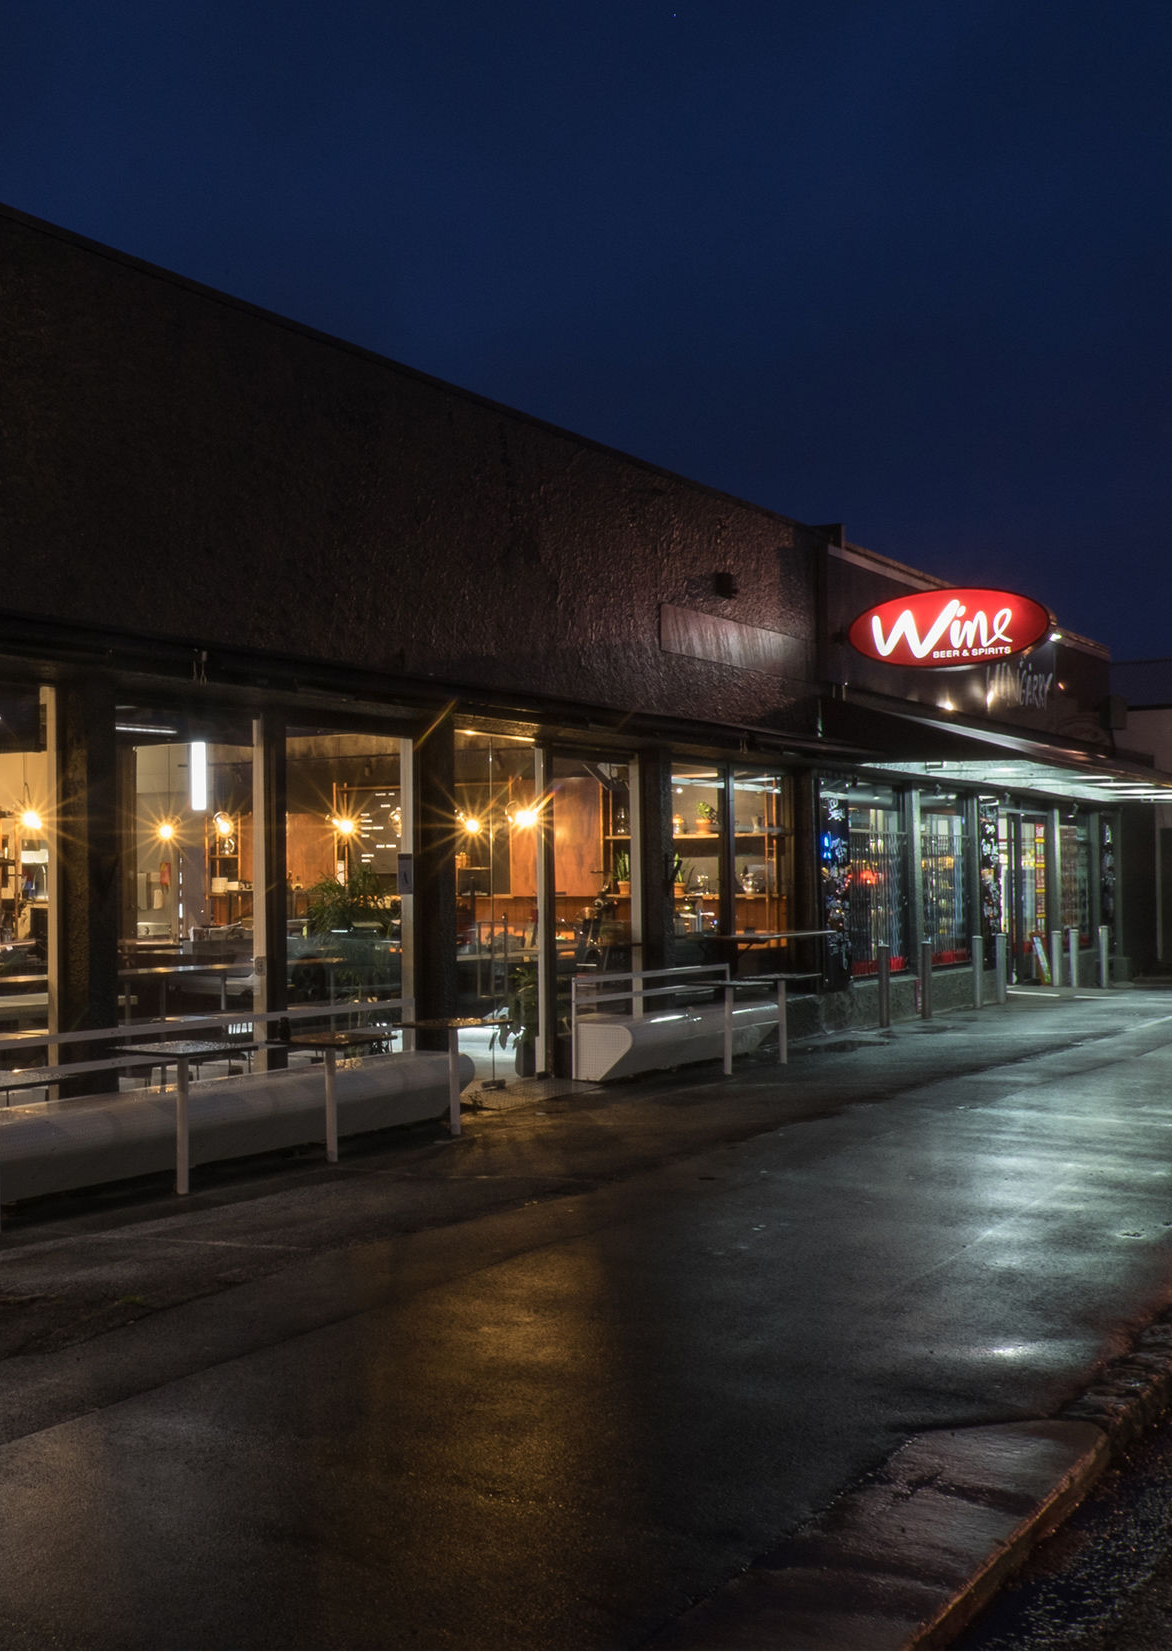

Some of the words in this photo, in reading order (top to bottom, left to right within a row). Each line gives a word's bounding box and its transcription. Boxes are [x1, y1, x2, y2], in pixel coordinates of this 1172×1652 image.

[871, 598, 1014, 659] Wine
[932, 649, 960, 659] BEER
[961, 649, 970, 658] &
[971, 645, 1012, 657] SPIRITS
